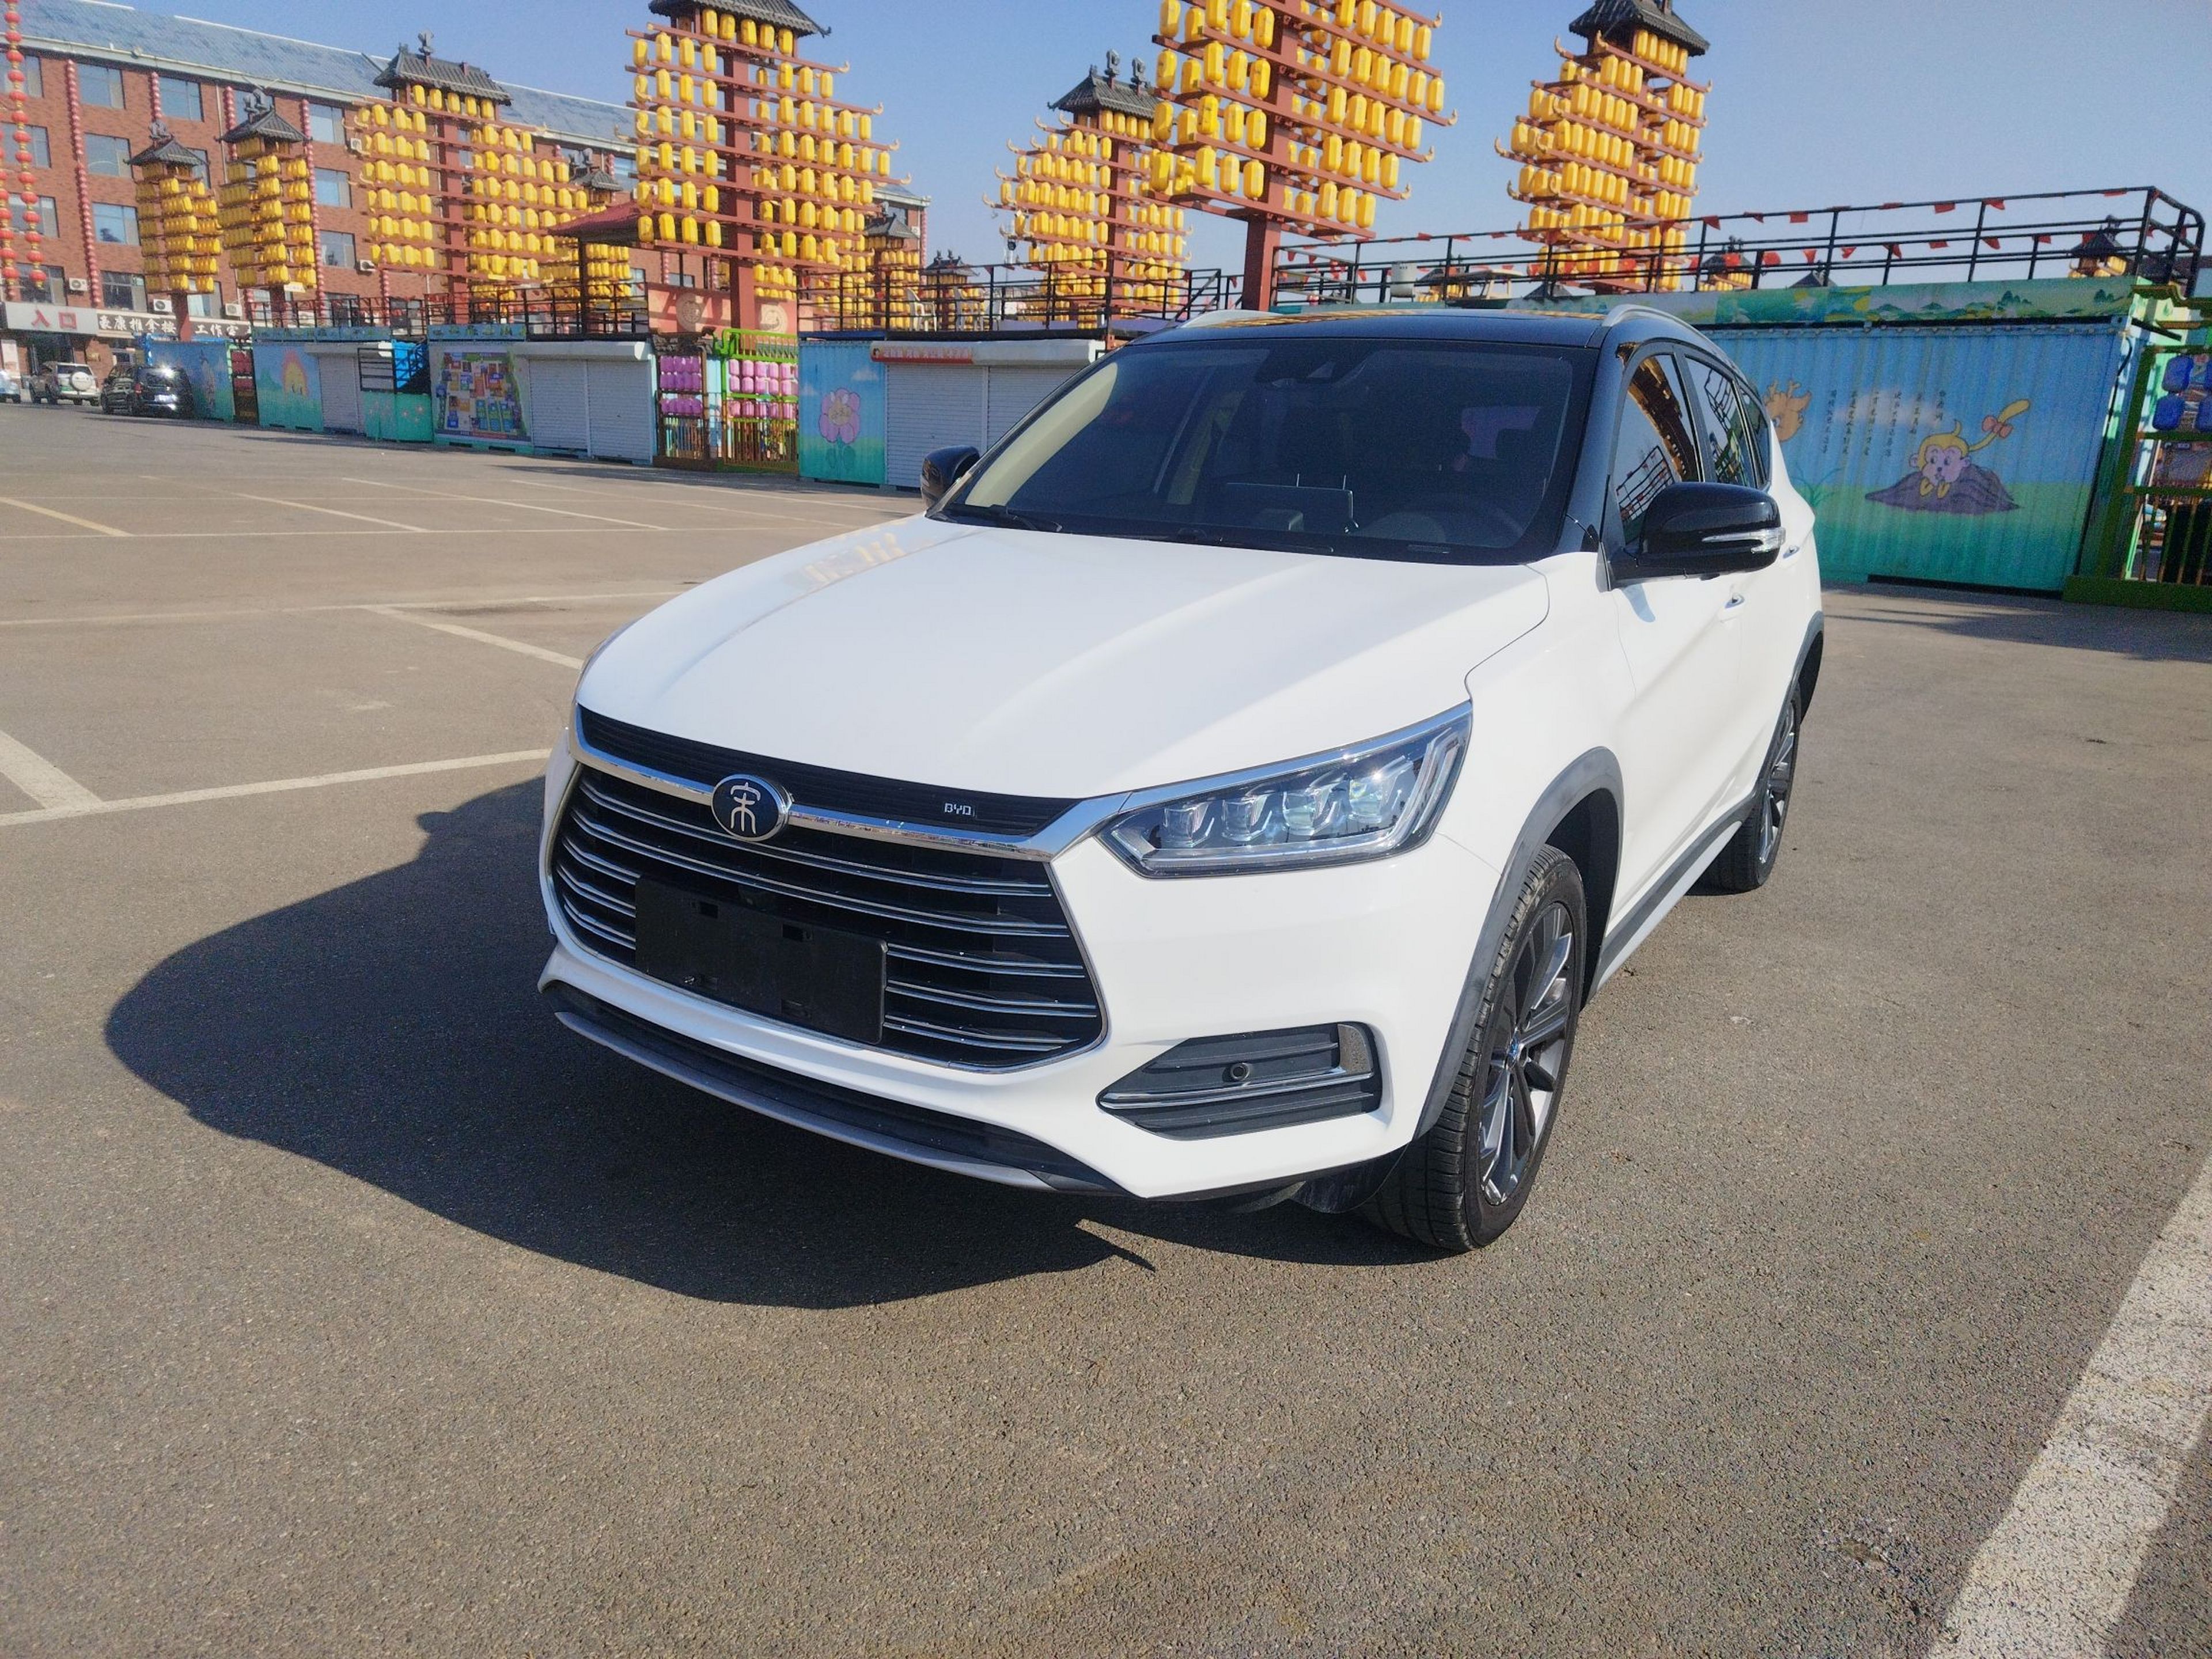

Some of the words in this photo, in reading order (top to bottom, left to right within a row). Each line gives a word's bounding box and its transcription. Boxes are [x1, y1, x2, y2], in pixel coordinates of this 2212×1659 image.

[31, 309, 77, 330] 入口
[730, 782, 761, 834] 宋
[945, 803, 972, 816] BYD
